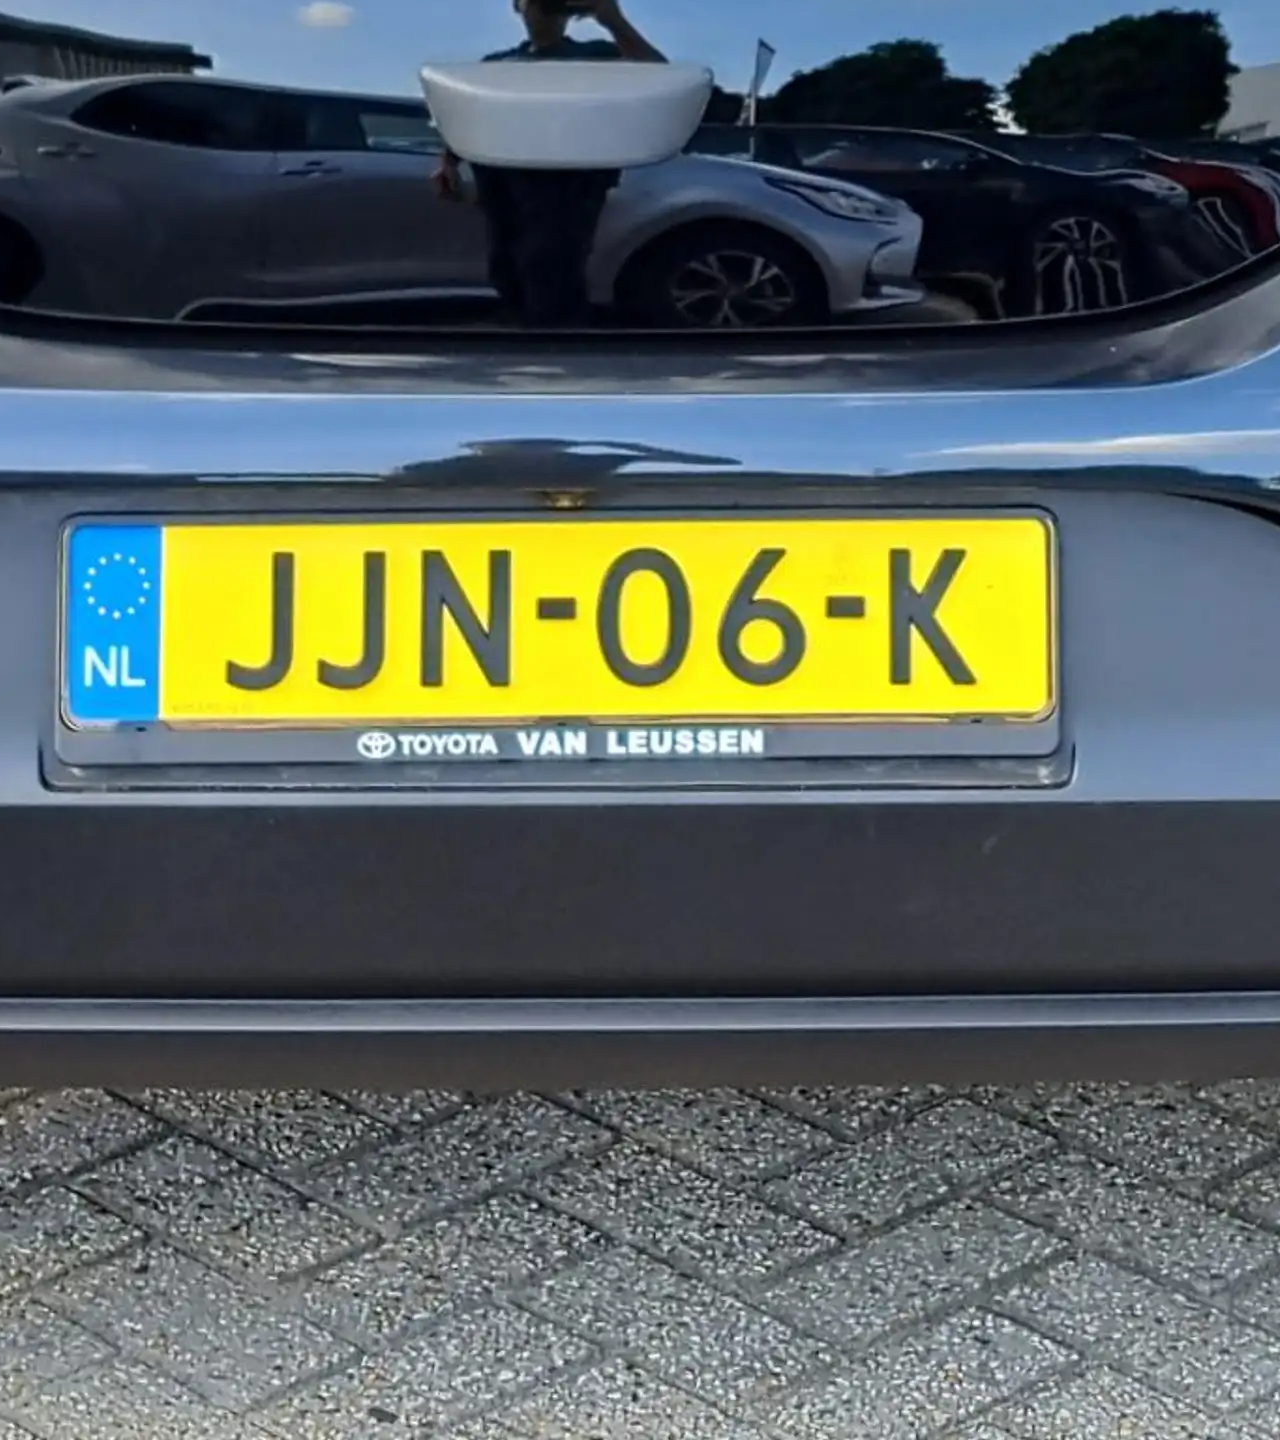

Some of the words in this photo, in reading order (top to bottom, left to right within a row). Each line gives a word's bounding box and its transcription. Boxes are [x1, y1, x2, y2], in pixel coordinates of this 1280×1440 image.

[225, 546, 978, 692] JJN-06-K
[83, 644, 147, 688] NL
[397, 732, 499, 756] TOYOTA
[516, 730, 587, 755] VAN
[606, 727, 765, 754] LEUSSEN
